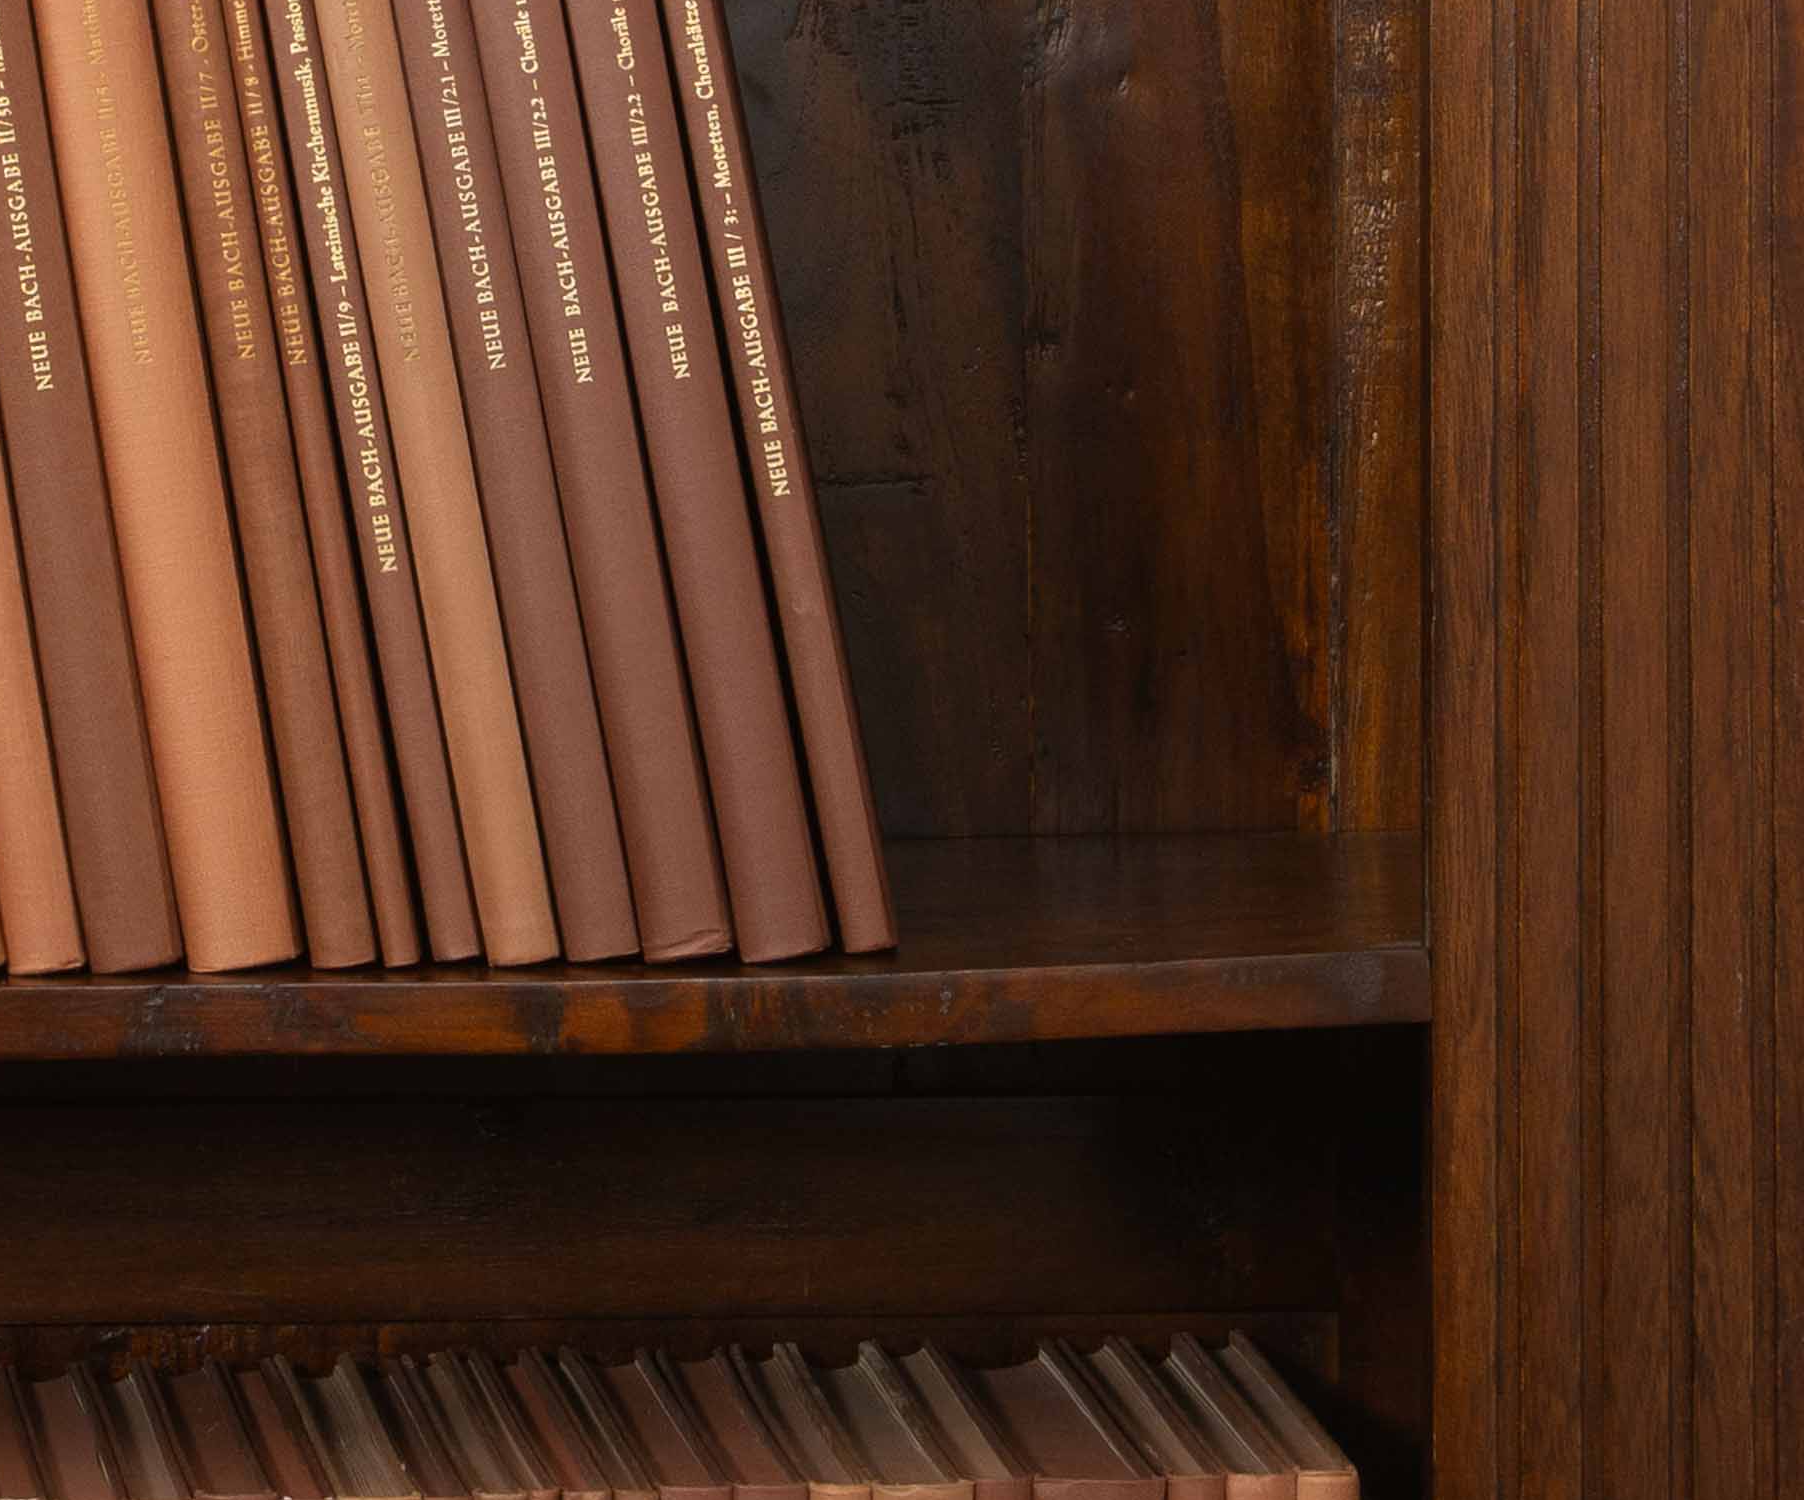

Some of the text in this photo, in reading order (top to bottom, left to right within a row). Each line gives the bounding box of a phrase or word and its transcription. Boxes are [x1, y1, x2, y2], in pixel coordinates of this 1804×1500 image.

[513, 9, 539, 73] Choräle
[684, 0, 714, 99] Choralsätze
[293, 56, 330, 183] Kirchenmusik,
[439, 74, 463, 128] III/2.1
[530, 96, 552, 150] III/2.2
[706, 103, 732, 188] Motetten,
[1, 152, 43, 322] BACH-AUSGABE
[315, 185, 348, 283] Lateinische
[447, 130, 494, 304] BACH-AUSGABE
[537, 154, 581, 317] BACH-AUSGABE
[336, 300, 357, 336] II/9
[479, 309, 507, 370] NEUE
[567, 327, 593, 383] NEUE
[731, 273, 778, 434] BACH-AUSGABE
[27, 330, 54, 391] NEUE
[341, 340, 387, 507] BACH-AUSGABE
[763, 438, 791, 496] NEUE
[371, 513, 398, 572] NEUE
